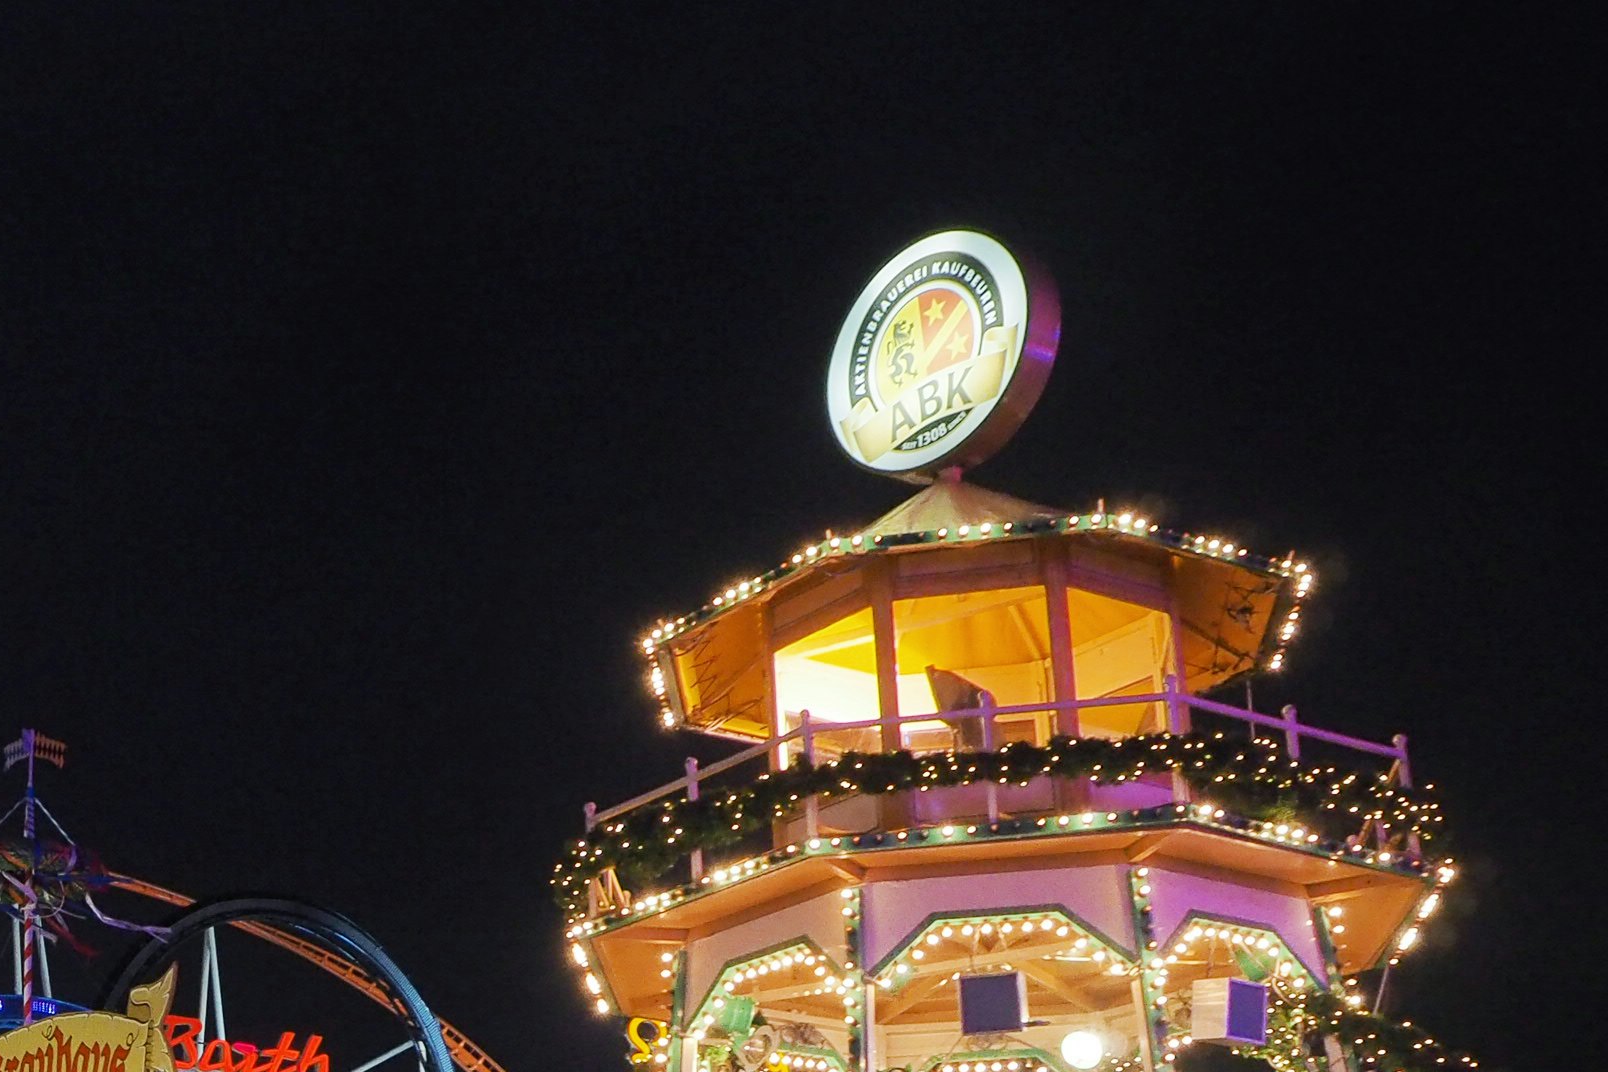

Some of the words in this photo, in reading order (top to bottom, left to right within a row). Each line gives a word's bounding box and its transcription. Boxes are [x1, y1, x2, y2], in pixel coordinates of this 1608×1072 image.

[854, 263, 929, 397] AKTIENBRAUEREI
[931, 260, 999, 327] KAUFBEUREN
[890, 365, 974, 444] ABK
[916, 421, 949, 448] 1308
